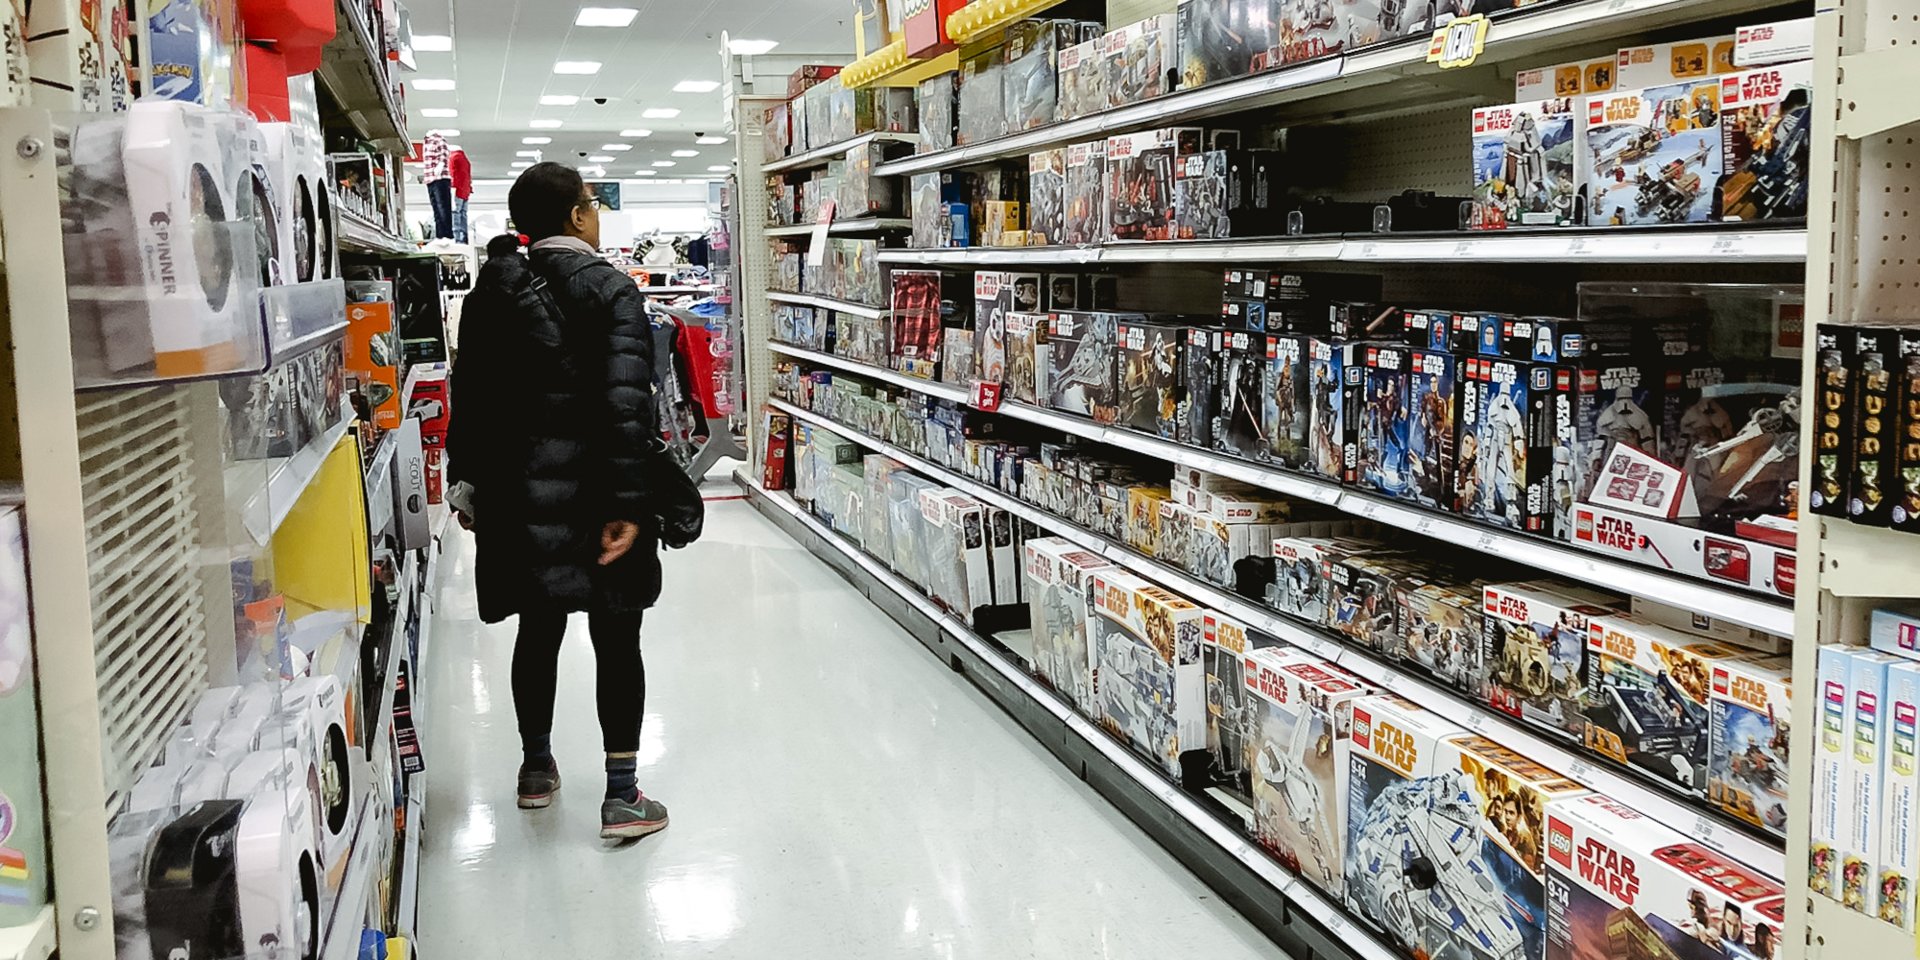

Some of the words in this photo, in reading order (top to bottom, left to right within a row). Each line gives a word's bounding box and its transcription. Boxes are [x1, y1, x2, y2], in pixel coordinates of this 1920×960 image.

[1443, 21, 1479, 62] NEW!
[1742, 71, 1782, 88] STAR
[1742, 83, 1782, 100] WARS
[1606, 96, 1640, 111] STAR
[1487, 109, 1512, 120] STAR
[1606, 107, 1640, 122] WARS
[1487, 119, 1512, 131] WARS
[1277, 338, 1298, 350] STAR
[1378, 358, 1400, 370] WARS
[1379, 350, 1398, 361] STAR
[1424, 355, 1444, 366] STAR
[1423, 363, 1445, 376] WARS
[1492, 362, 1516, 375] STAR
[1601, 367, 1641, 379] STAR
[1687, 368, 1724, 380] STAR
[1491, 371, 1517, 385] WARS
[1600, 377, 1640, 390] WARS
[409, 456, 420, 491] SCOUT
[1527, 484, 1535, 515] STAR
[1533, 484, 1541, 515] WARS
[1598, 516, 1635, 537] STAR
[1597, 529, 1635, 551] WARS
[1332, 573, 1348, 587] WARS
[1333, 565, 1348, 577] STAR
[1107, 586, 1127, 603] STAR
[1106, 596, 1128, 618] WARS
[1501, 596, 1528, 612] STAR
[1501, 605, 1528, 621] WARS
[1218, 622, 1243, 640] STAR
[1607, 631, 1636, 648] STAR
[1218, 632, 1244, 654] WARS
[1606, 640, 1635, 660] WARS
[1260, 668, 1288, 691] STAR
[1732, 677, 1767, 695] STAR
[1259, 680, 1288, 704] WARS
[1731, 687, 1767, 709] WARS
[1824, 685, 1843, 747] LIFE
[1354, 719, 1369, 735] LEGO
[1857, 694, 1876, 757] LIFE
[1374, 721, 1417, 754] STAR
[1894, 705, 1915, 770] LIFE
[1374, 736, 1417, 772] WARS
[1351, 760, 1367, 780] 9-14
[1551, 831, 1570, 856] LEGO
[1577, 837, 1640, 886] STAR
[1578, 855, 1640, 905] WARS
[1548, 880, 1569, 907] 9-14
